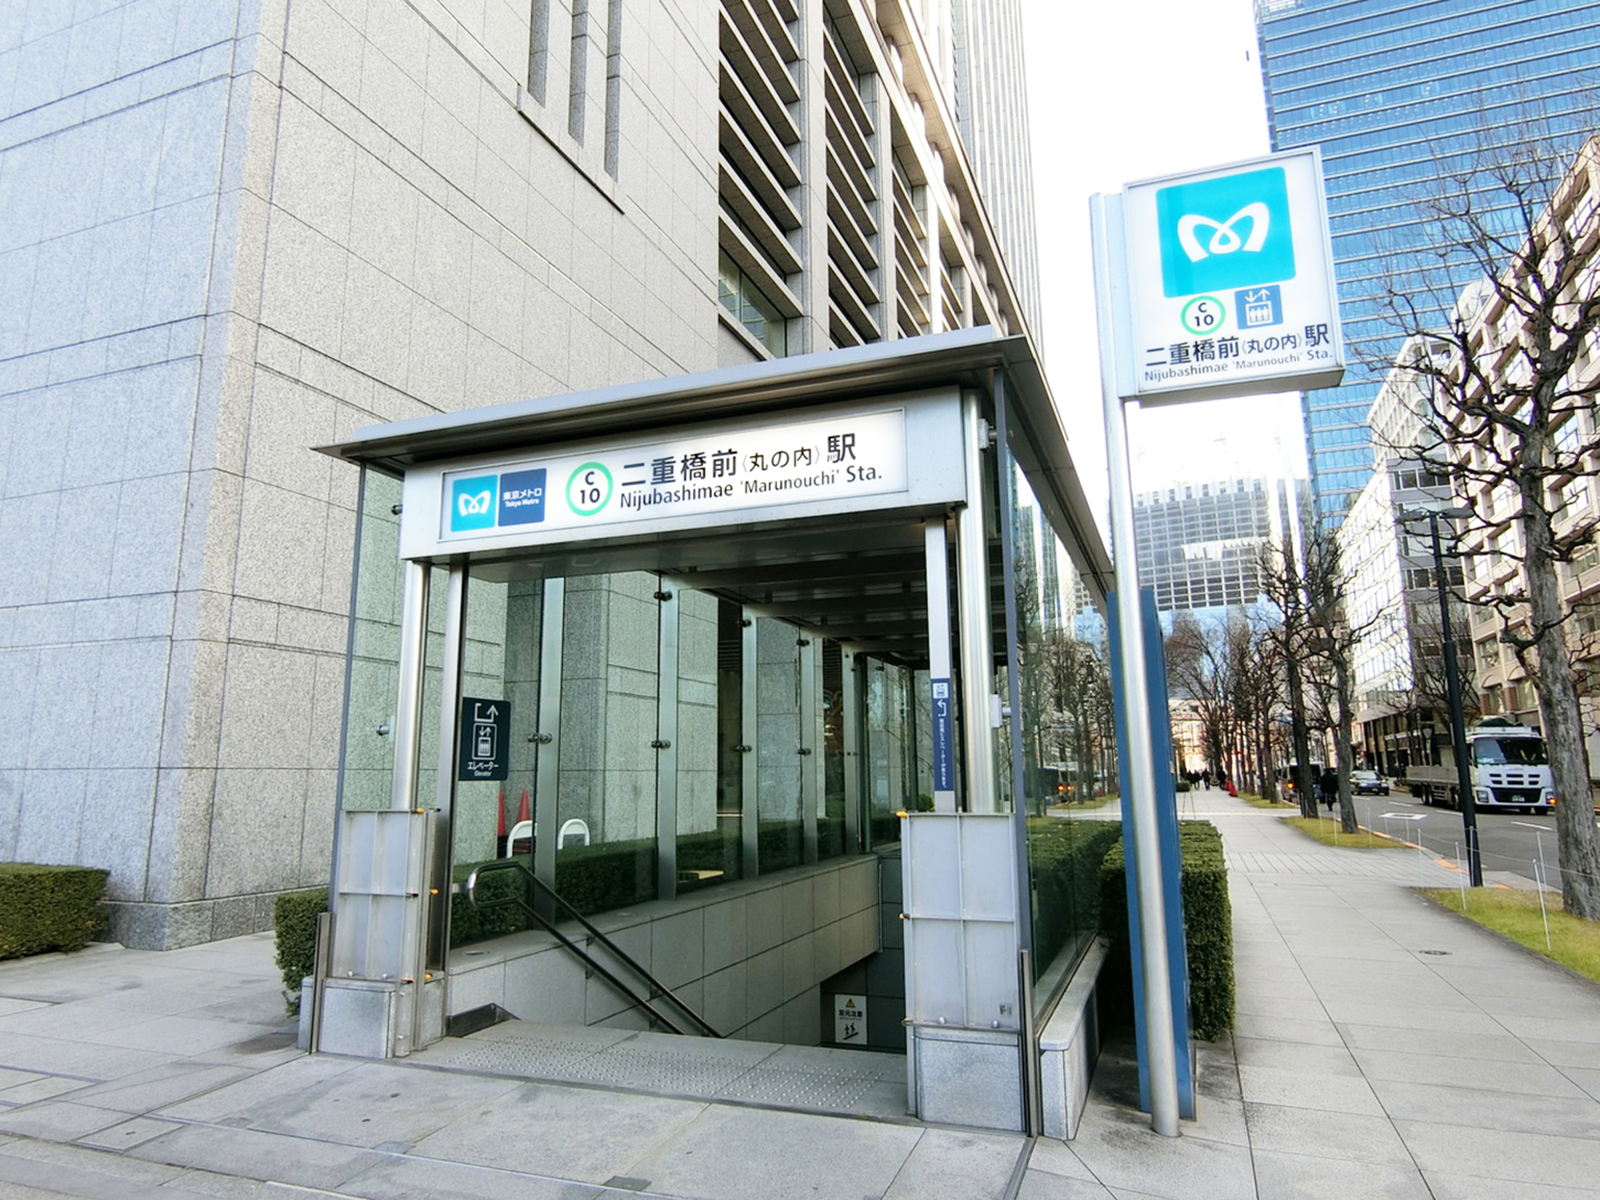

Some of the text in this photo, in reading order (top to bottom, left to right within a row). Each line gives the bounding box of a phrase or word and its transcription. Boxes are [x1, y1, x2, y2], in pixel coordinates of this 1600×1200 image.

[1198, 302, 1207, 313] C
[1194, 314, 1214, 327] 10
[1144, 362, 1228, 382] Nijubashimae
[1307, 349, 1333, 361] Sta.
[584, 471, 595, 485] C
[503, 487, 542, 501] 東京メトロ
[620, 483, 733, 511] Nijubashimae
[846, 465, 882, 483] Sta.
[505, 498, 539, 508] Tokyo Metro
[580, 488, 600, 504] 10
